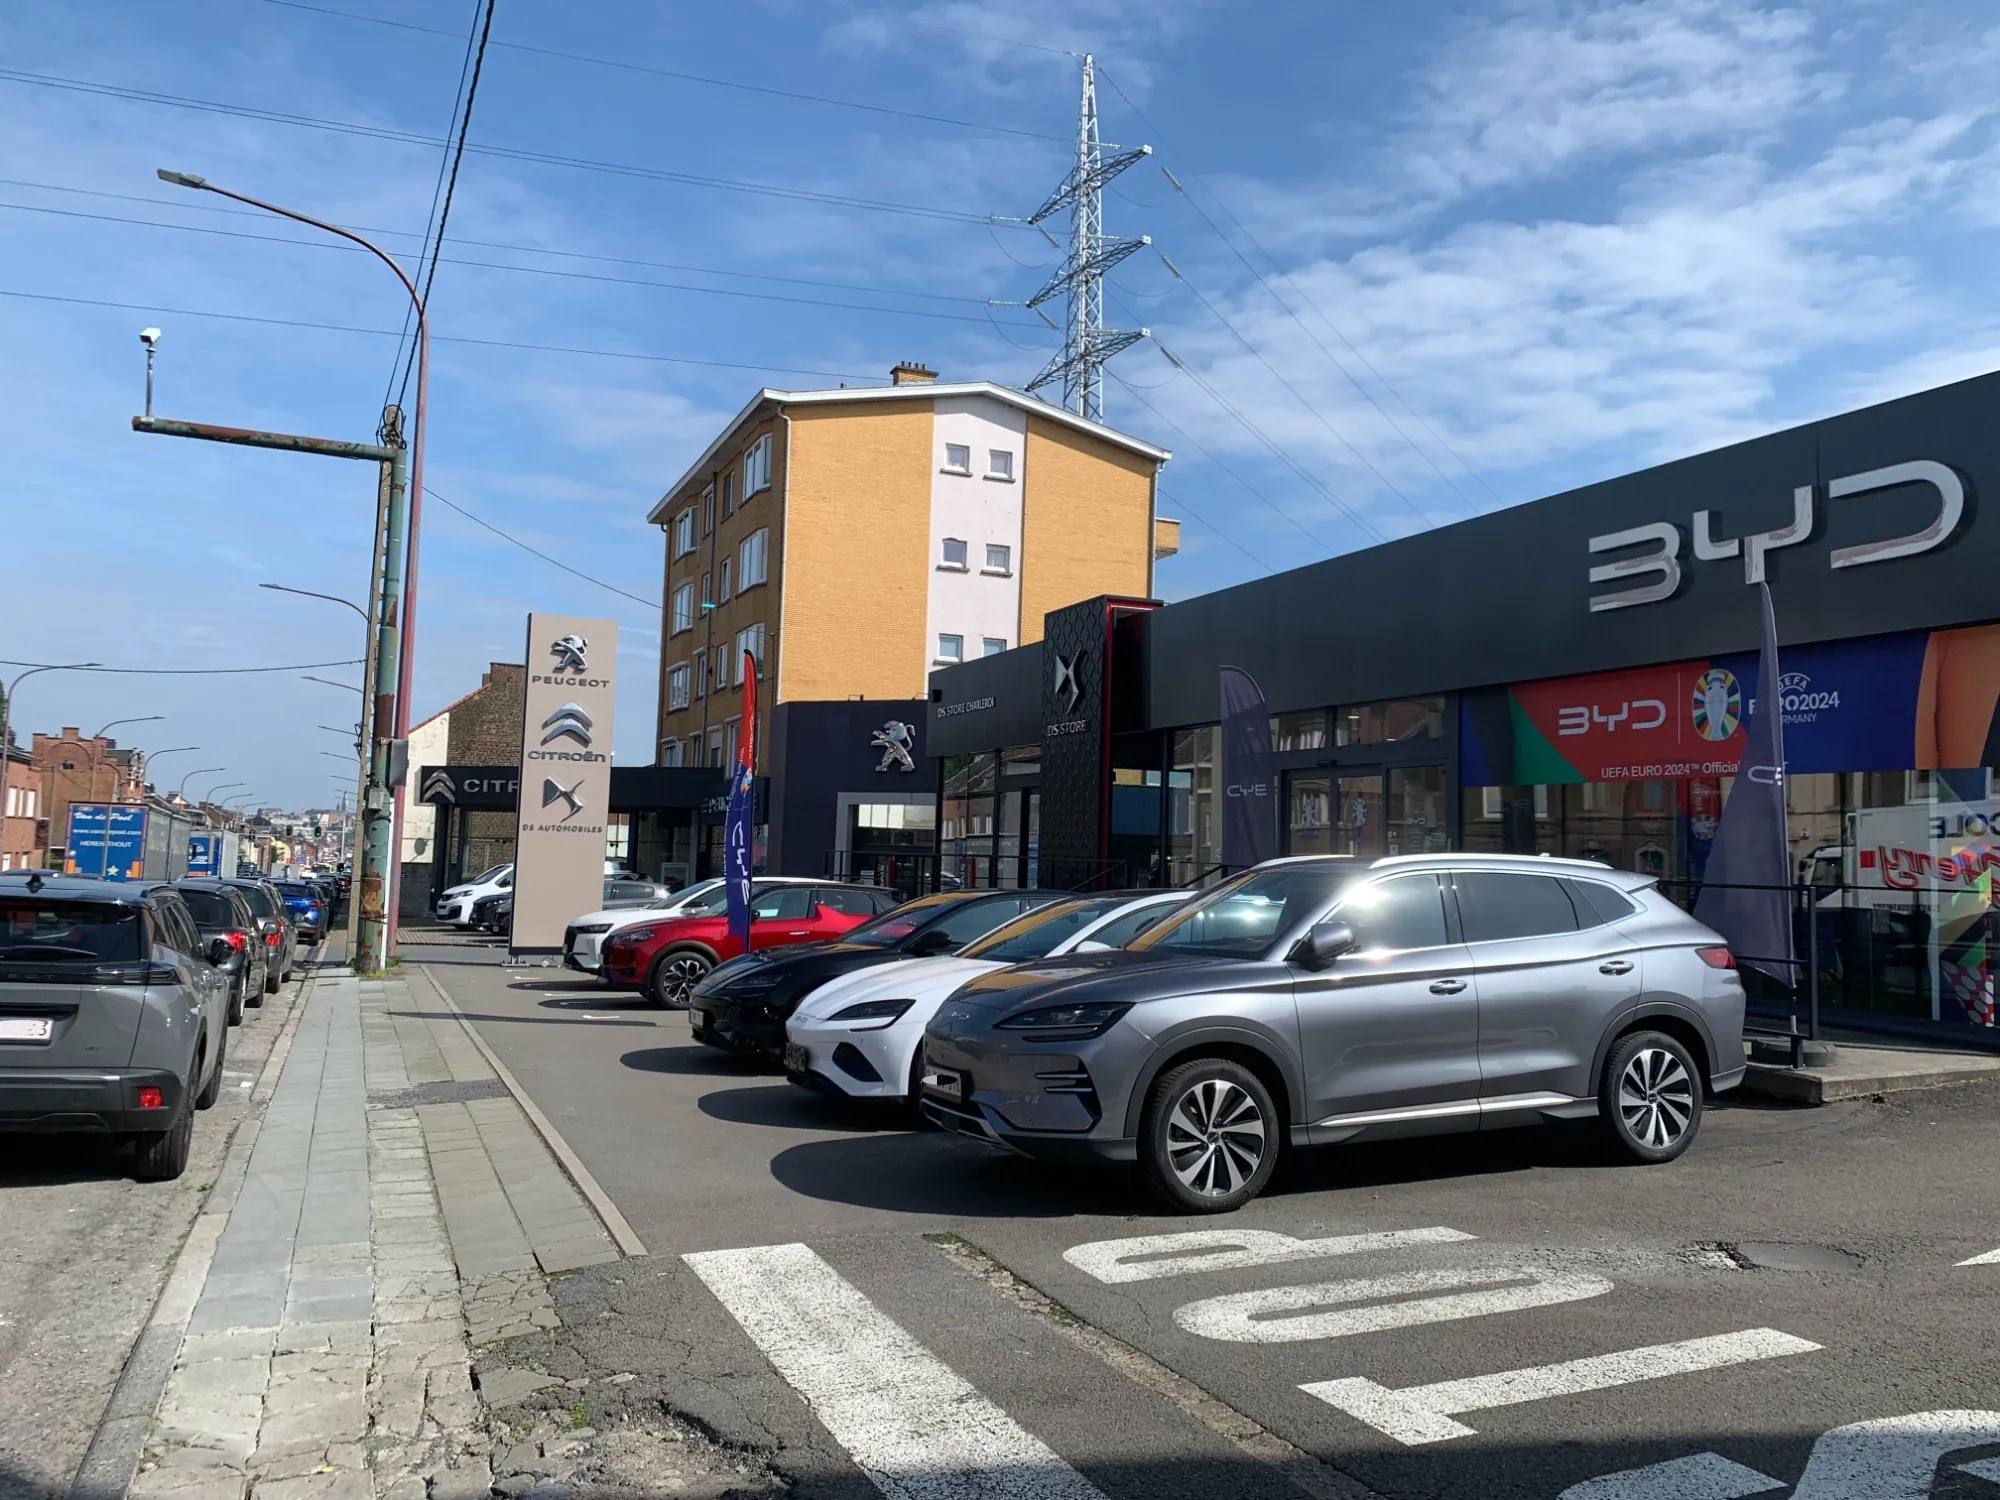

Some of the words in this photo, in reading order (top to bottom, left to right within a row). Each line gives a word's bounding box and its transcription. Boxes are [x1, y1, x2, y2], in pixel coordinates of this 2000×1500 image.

[1589, 460, 1964, 612] BYD
[532, 675, 610, 688] PEUGEOT
[946, 702, 965, 716] STORE
[1559, 699, 1666, 736] BYD
[1047, 724, 1059, 736] DS
[1060, 719, 1085, 734] STORE
[1601, 767, 1630, 778] UEFA
[1631, 765, 1662, 777] EURO
[1702, 761, 1741, 774] Officia
[522, 823, 535, 831] DS
[537, 823, 603, 833] AUTOMOBILES
